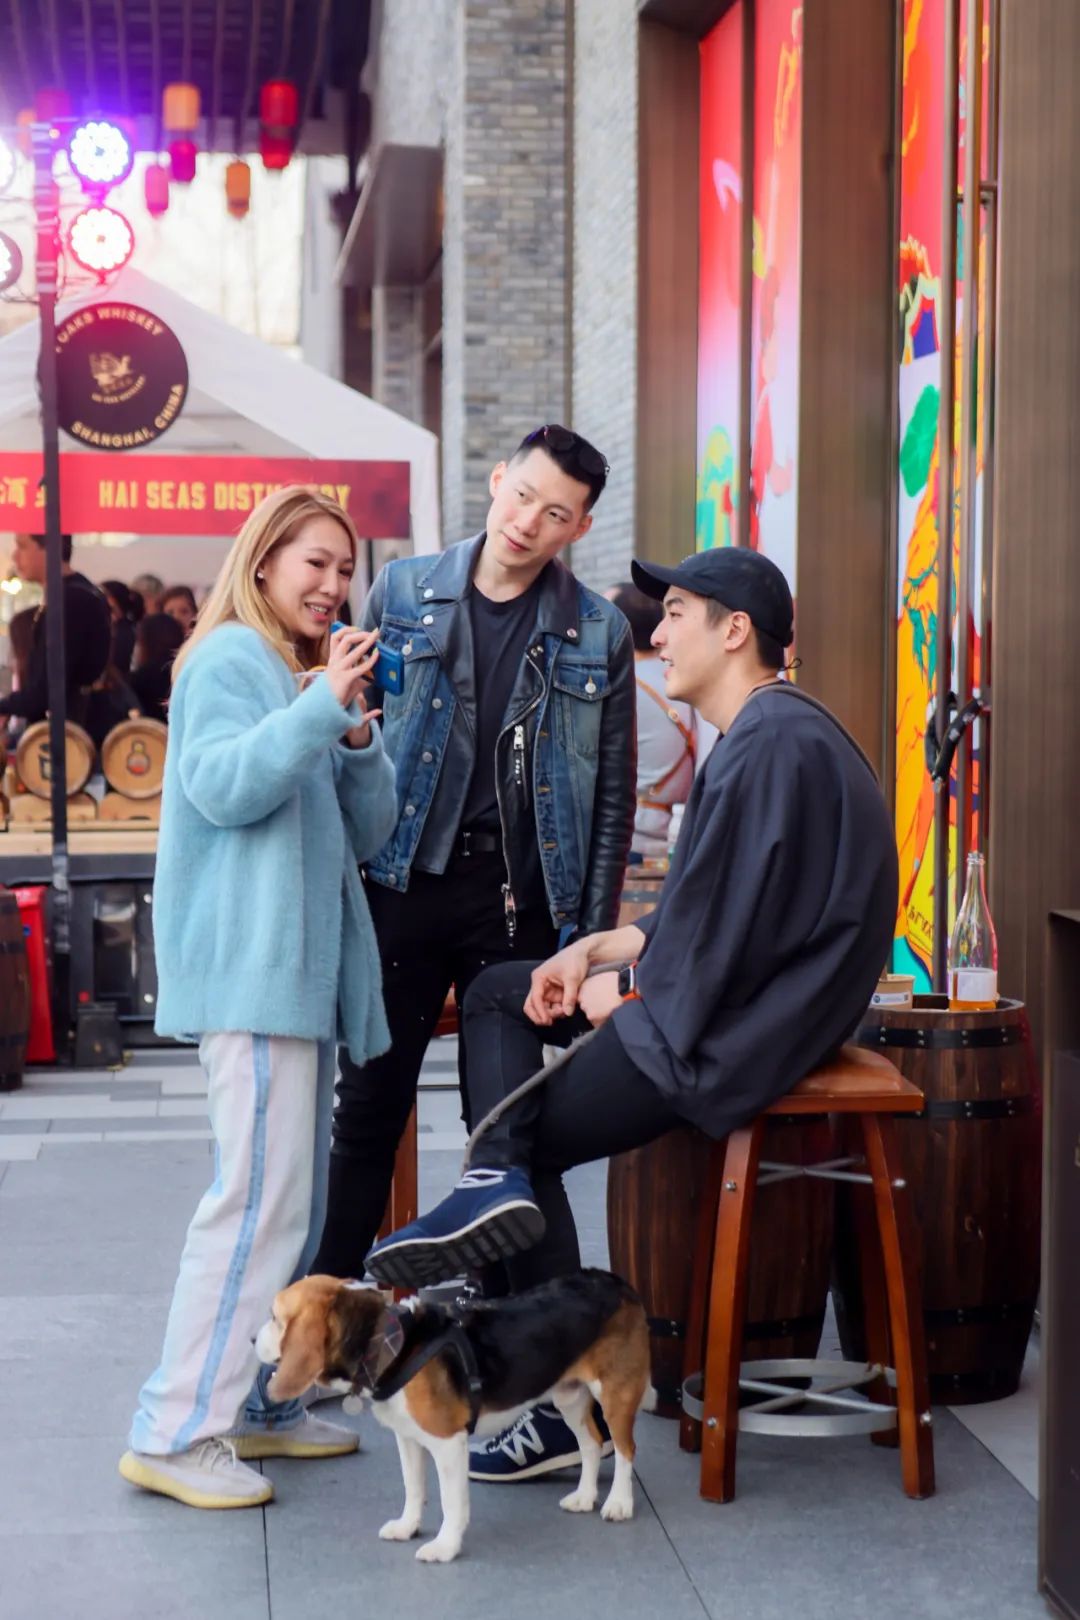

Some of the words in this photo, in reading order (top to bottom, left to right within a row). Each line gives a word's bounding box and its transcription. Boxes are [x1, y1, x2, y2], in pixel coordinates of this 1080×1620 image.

[97, 307, 162, 336] WHISKEY
[154, 384, 182, 429] CHINA
[99, 480, 138, 508] HAI
[146, 480, 206, 510] SEAS
